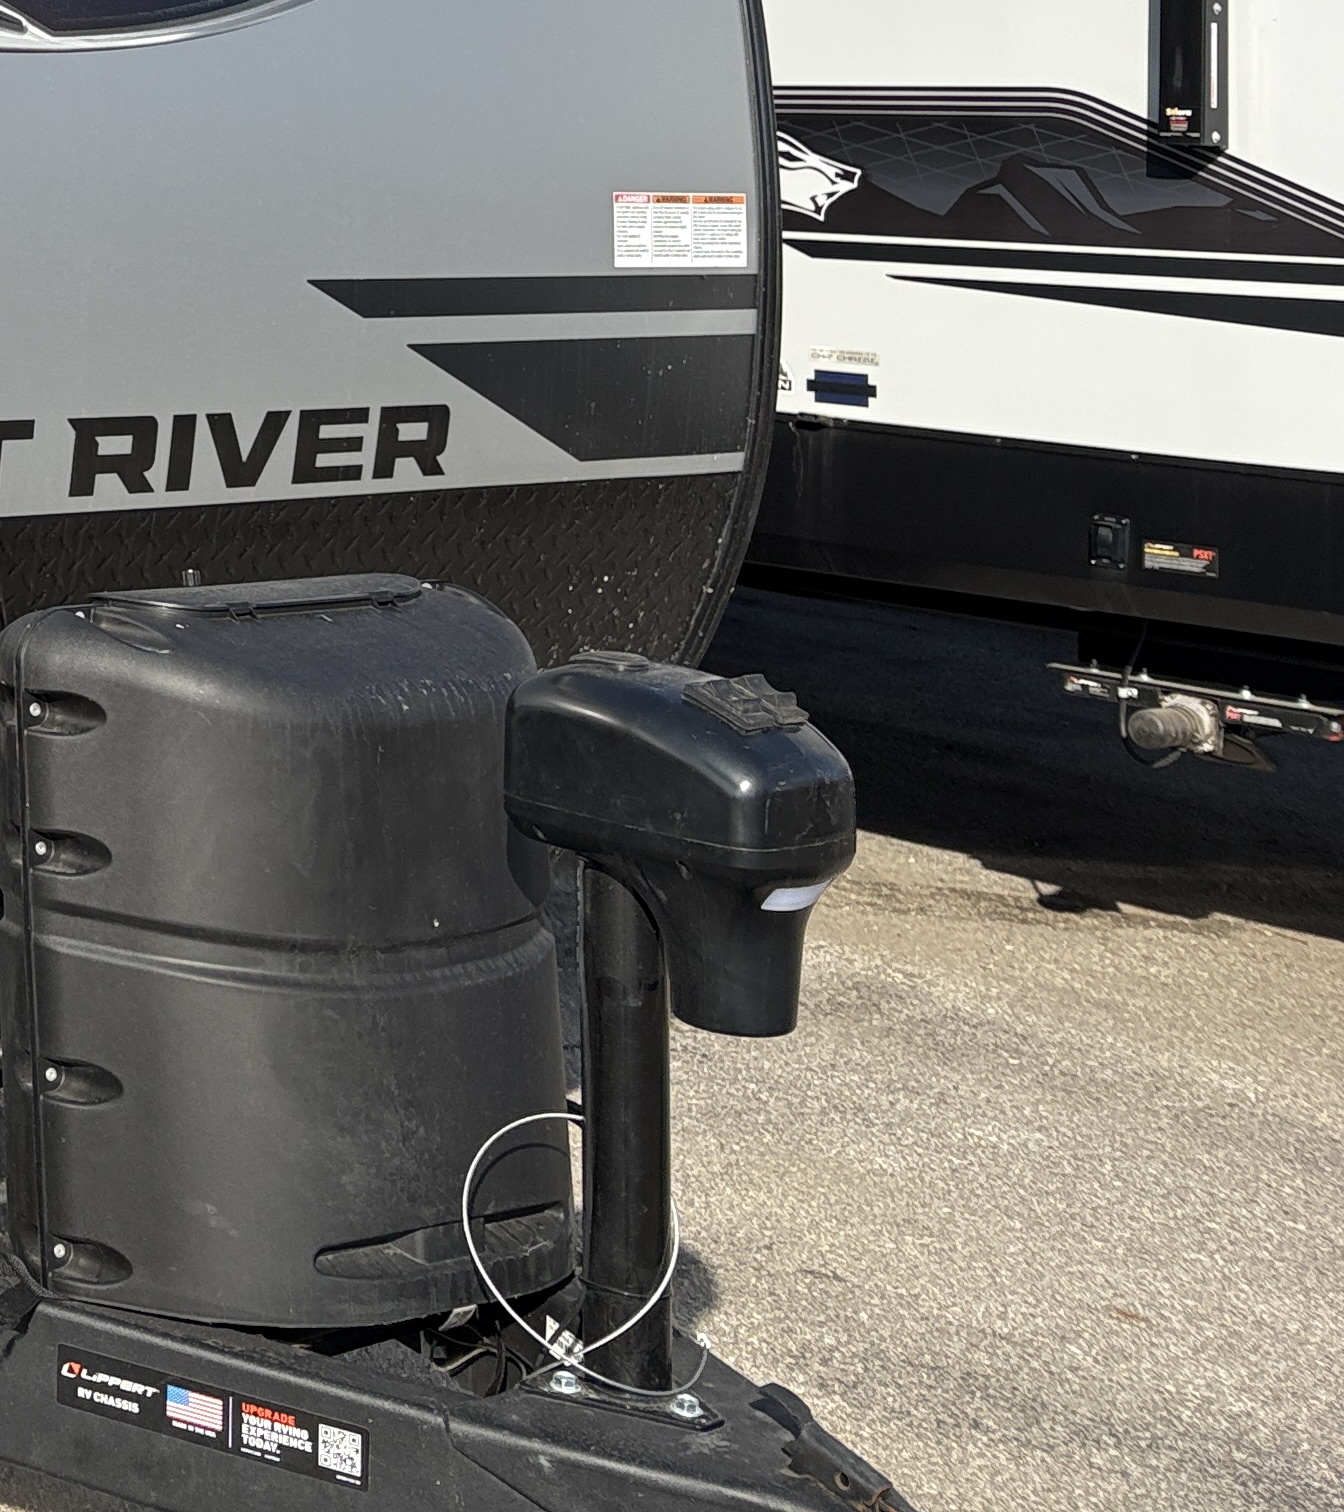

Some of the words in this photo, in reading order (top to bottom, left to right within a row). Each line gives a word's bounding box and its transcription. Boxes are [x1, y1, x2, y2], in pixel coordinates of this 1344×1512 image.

[67, 402, 453, 501] RIVER
[77, 1386, 92, 1400] RV
[93, 1390, 140, 1414] CHASSIS
[242, 1402, 295, 1426] UPGRADE
[242, 1413, 272, 1430] YOUR
[273, 1422, 309, 1440] RVING
[241, 1434, 281, 1454] TODAY.
[242, 1423, 312, 1453] EXPERIENCE
